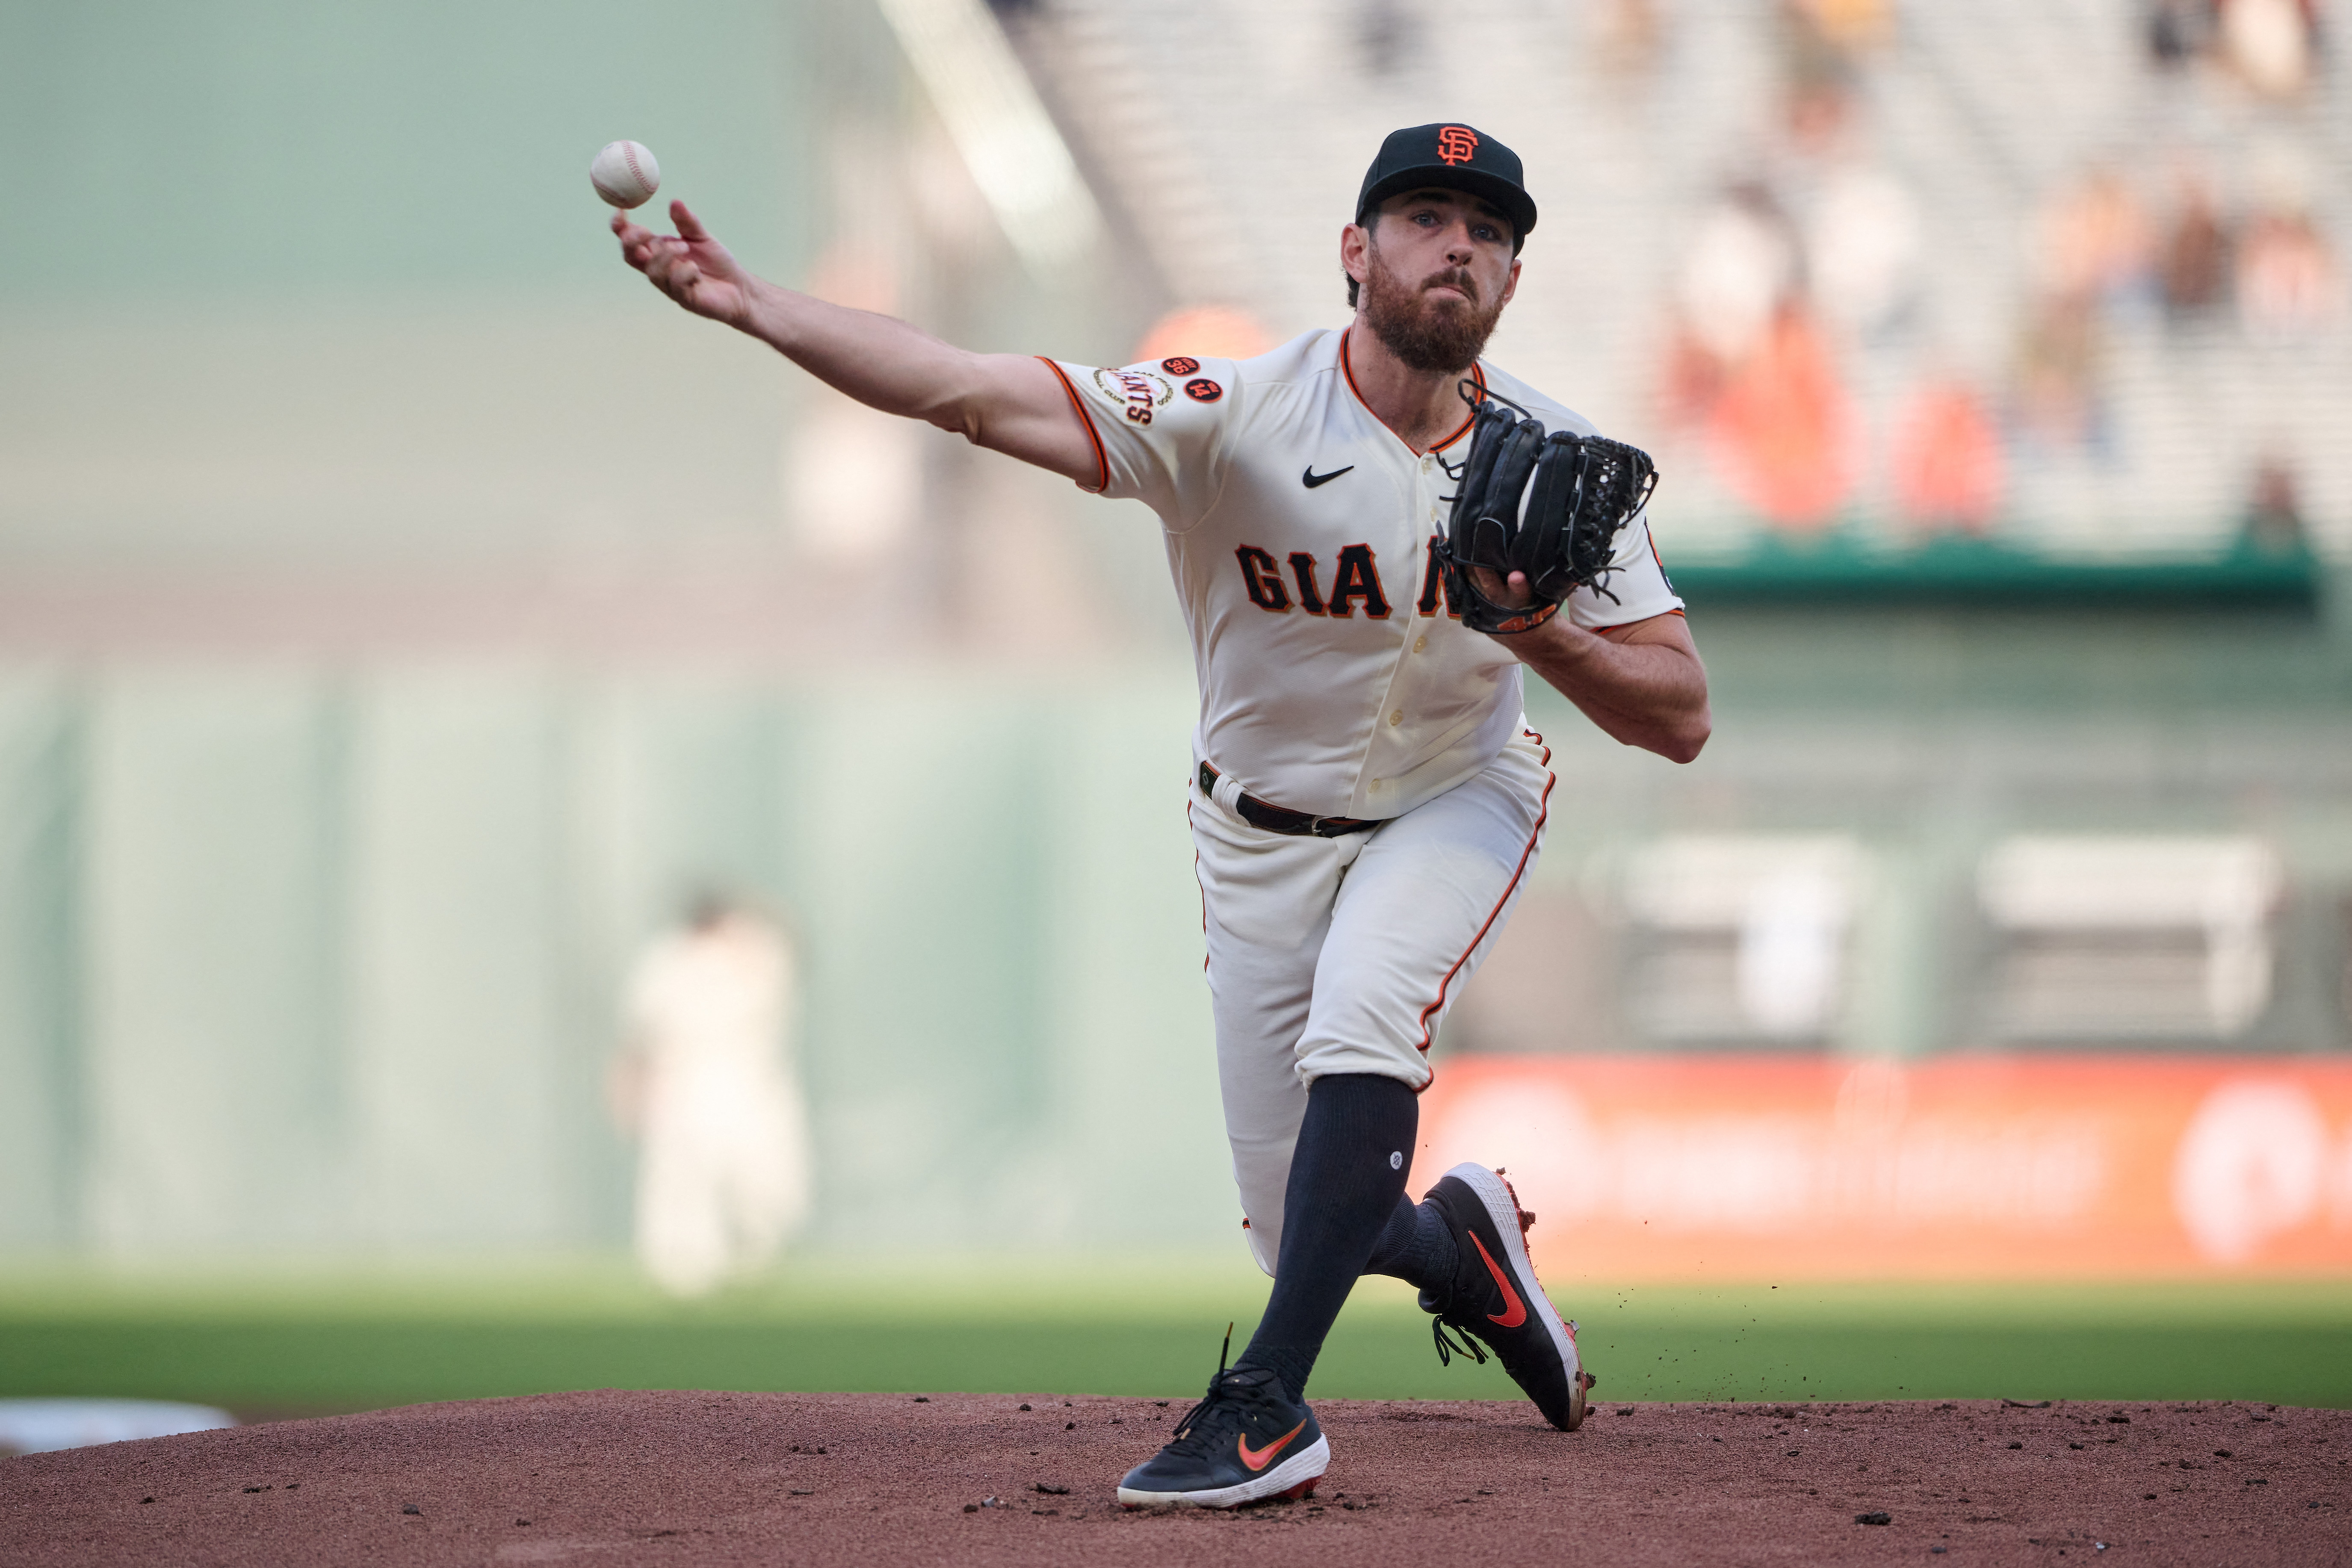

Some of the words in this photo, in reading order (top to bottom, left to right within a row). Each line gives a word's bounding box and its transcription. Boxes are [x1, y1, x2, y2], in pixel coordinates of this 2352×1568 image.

[1437, 126, 1479, 166] SF
[1166, 359, 1189, 374] 36
[1104, 389, 1126, 405] CLUB
[1189, 382, 1211, 398] 14
[1234, 534, 1462, 620] GIAN
